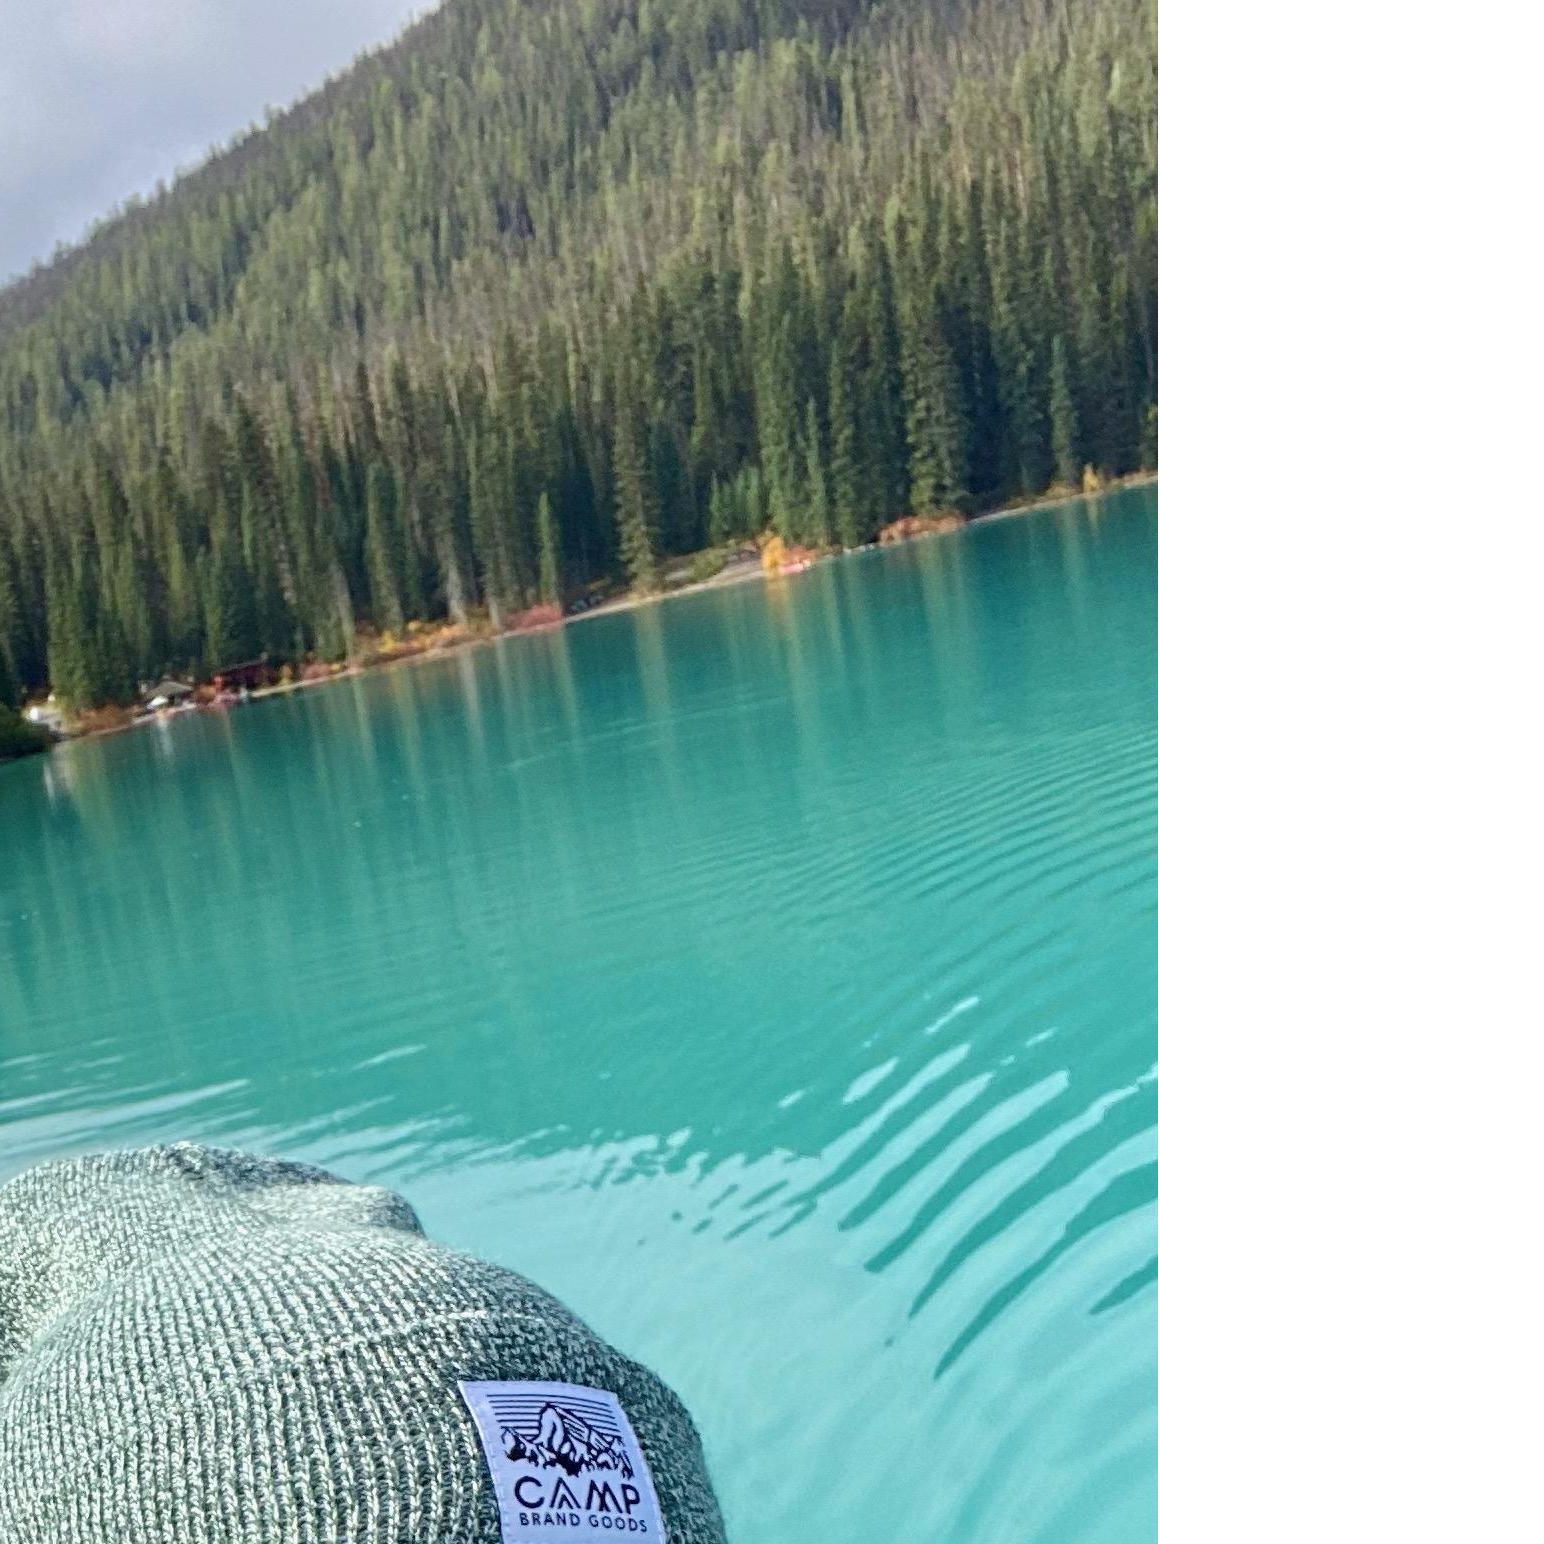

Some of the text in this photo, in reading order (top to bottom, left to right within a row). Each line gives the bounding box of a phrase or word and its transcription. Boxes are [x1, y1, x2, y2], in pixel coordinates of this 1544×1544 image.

[514, 1475, 641, 1515] CAMP
[519, 1512, 648, 1533] BRAND GOODS
